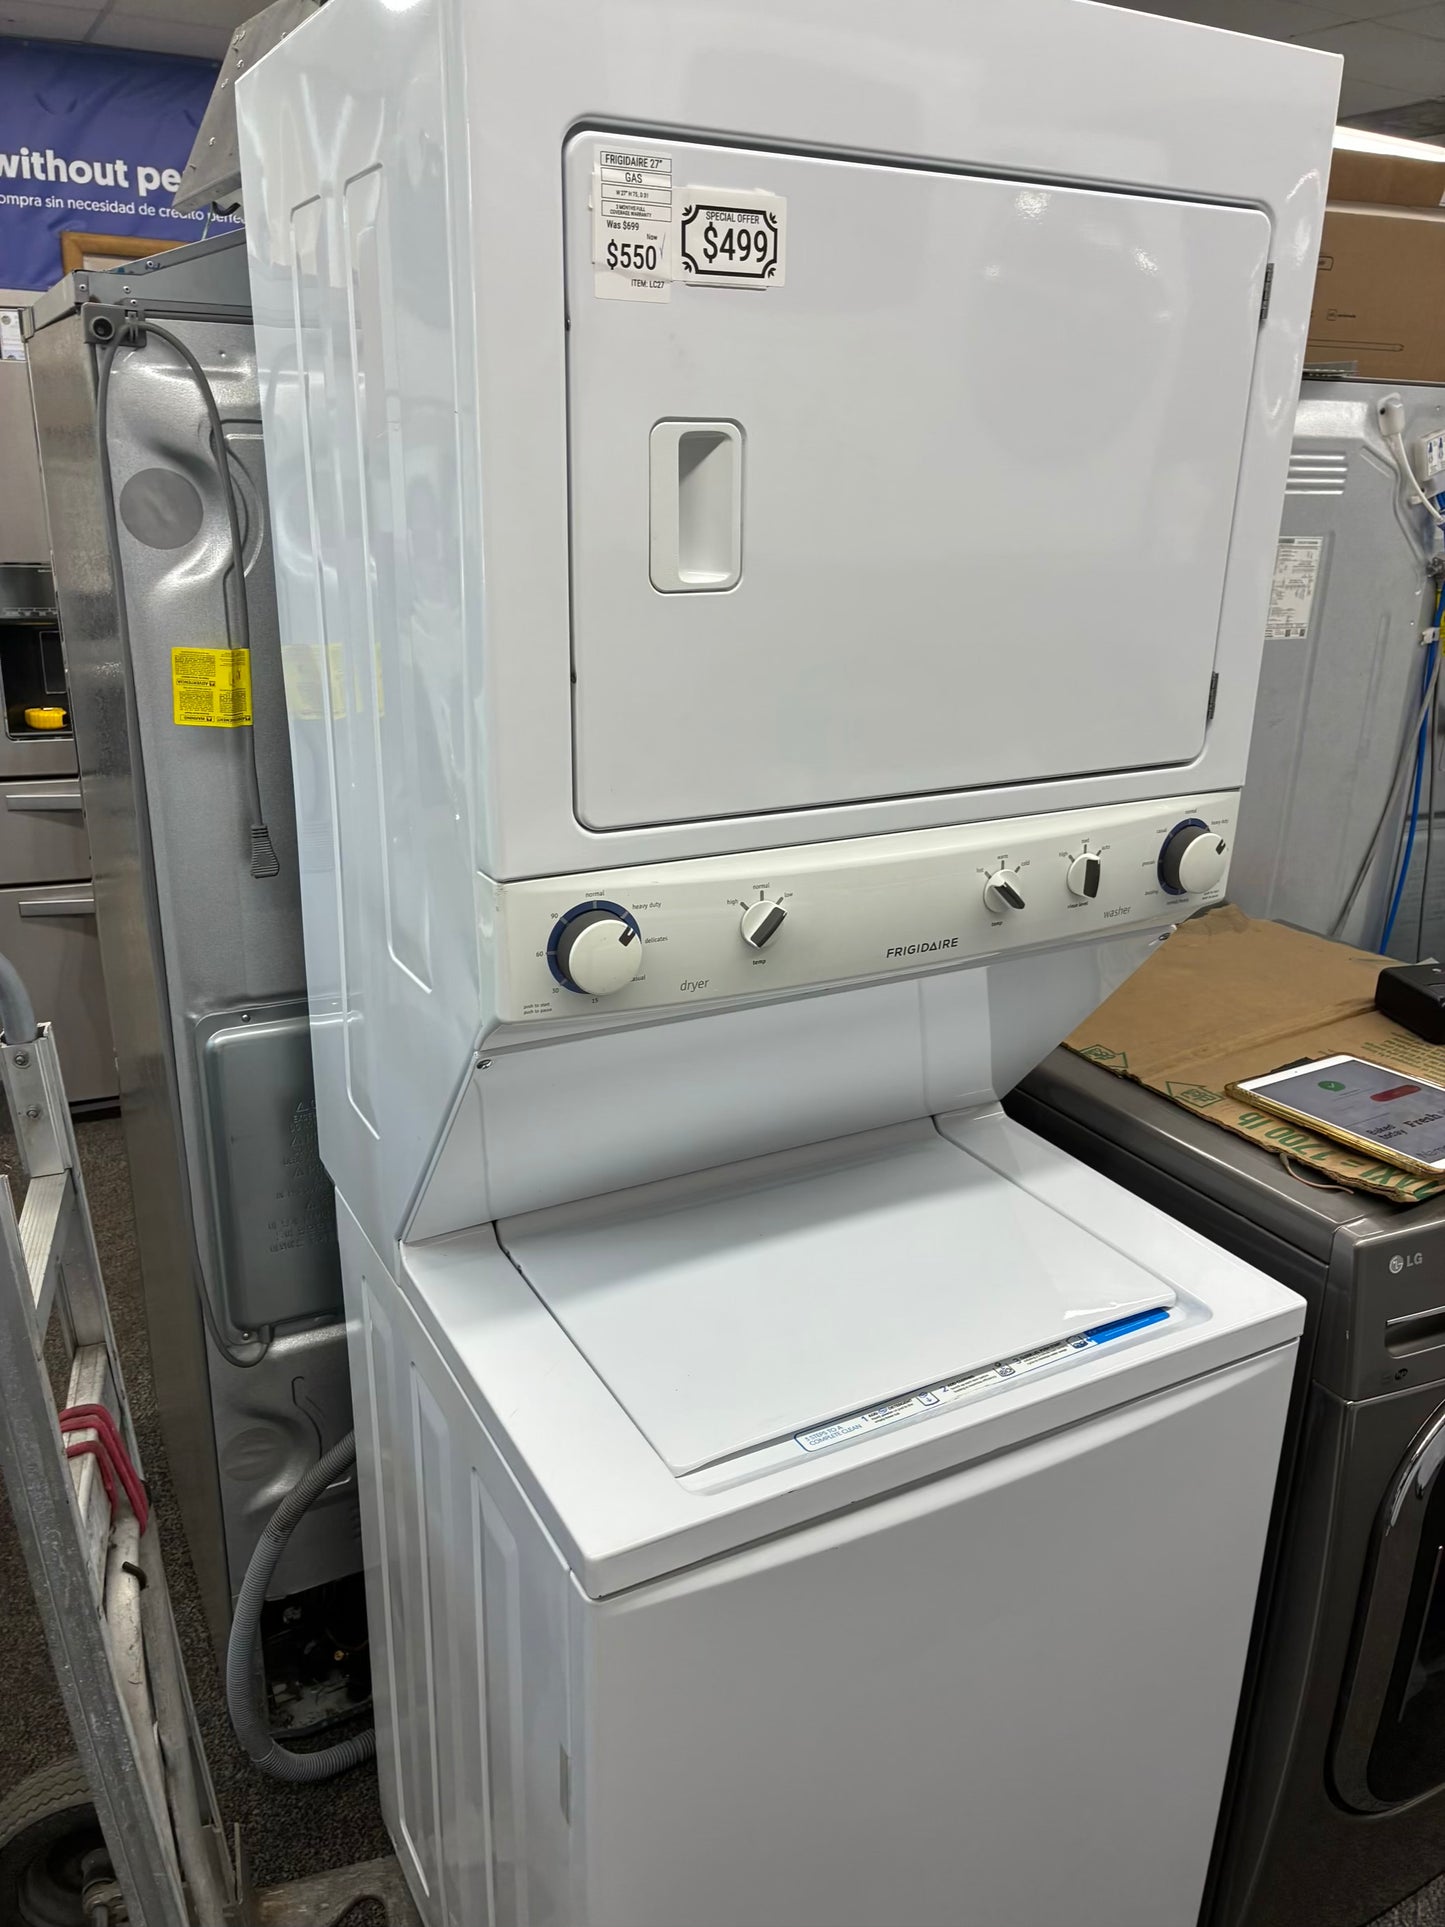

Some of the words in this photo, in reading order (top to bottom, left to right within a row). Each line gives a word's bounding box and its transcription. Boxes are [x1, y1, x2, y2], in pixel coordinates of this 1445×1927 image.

[605, 154, 648, 168] FRIGIDAIRE
[137, 166, 185, 197] pe
[625, 172, 643, 183] GAS
[45, 195, 64, 208] sin
[67, 199, 135, 214] necesidad
[138, 203, 156, 216] de
[705, 211, 736, 223] SPECIAL
[737, 214, 760, 224] OFFER
[606, 220, 621, 230] Was
[622, 220, 640, 231] $699
[703, 221, 768, 264] $499
[606, 238, 657, 270] $550
[631, 279, 648, 288] ITEM:
[649, 280, 665, 288] LC27
[585, 890, 605, 898] normal
[1104, 906, 1132, 918] washer
[645, 936, 668, 944] delicates
[886, 937, 959, 958] FRIGIDAIRE
[680, 979, 710, 992] dryer
[1264, 1126, 1340, 1161] 1700
[1406, 1252, 1423, 1267] LG
[809, 1431, 842, 1446] COMPLETE
[841, 1423, 862, 1435] CLEAN
[809, 1430, 828, 1440] STEPS
